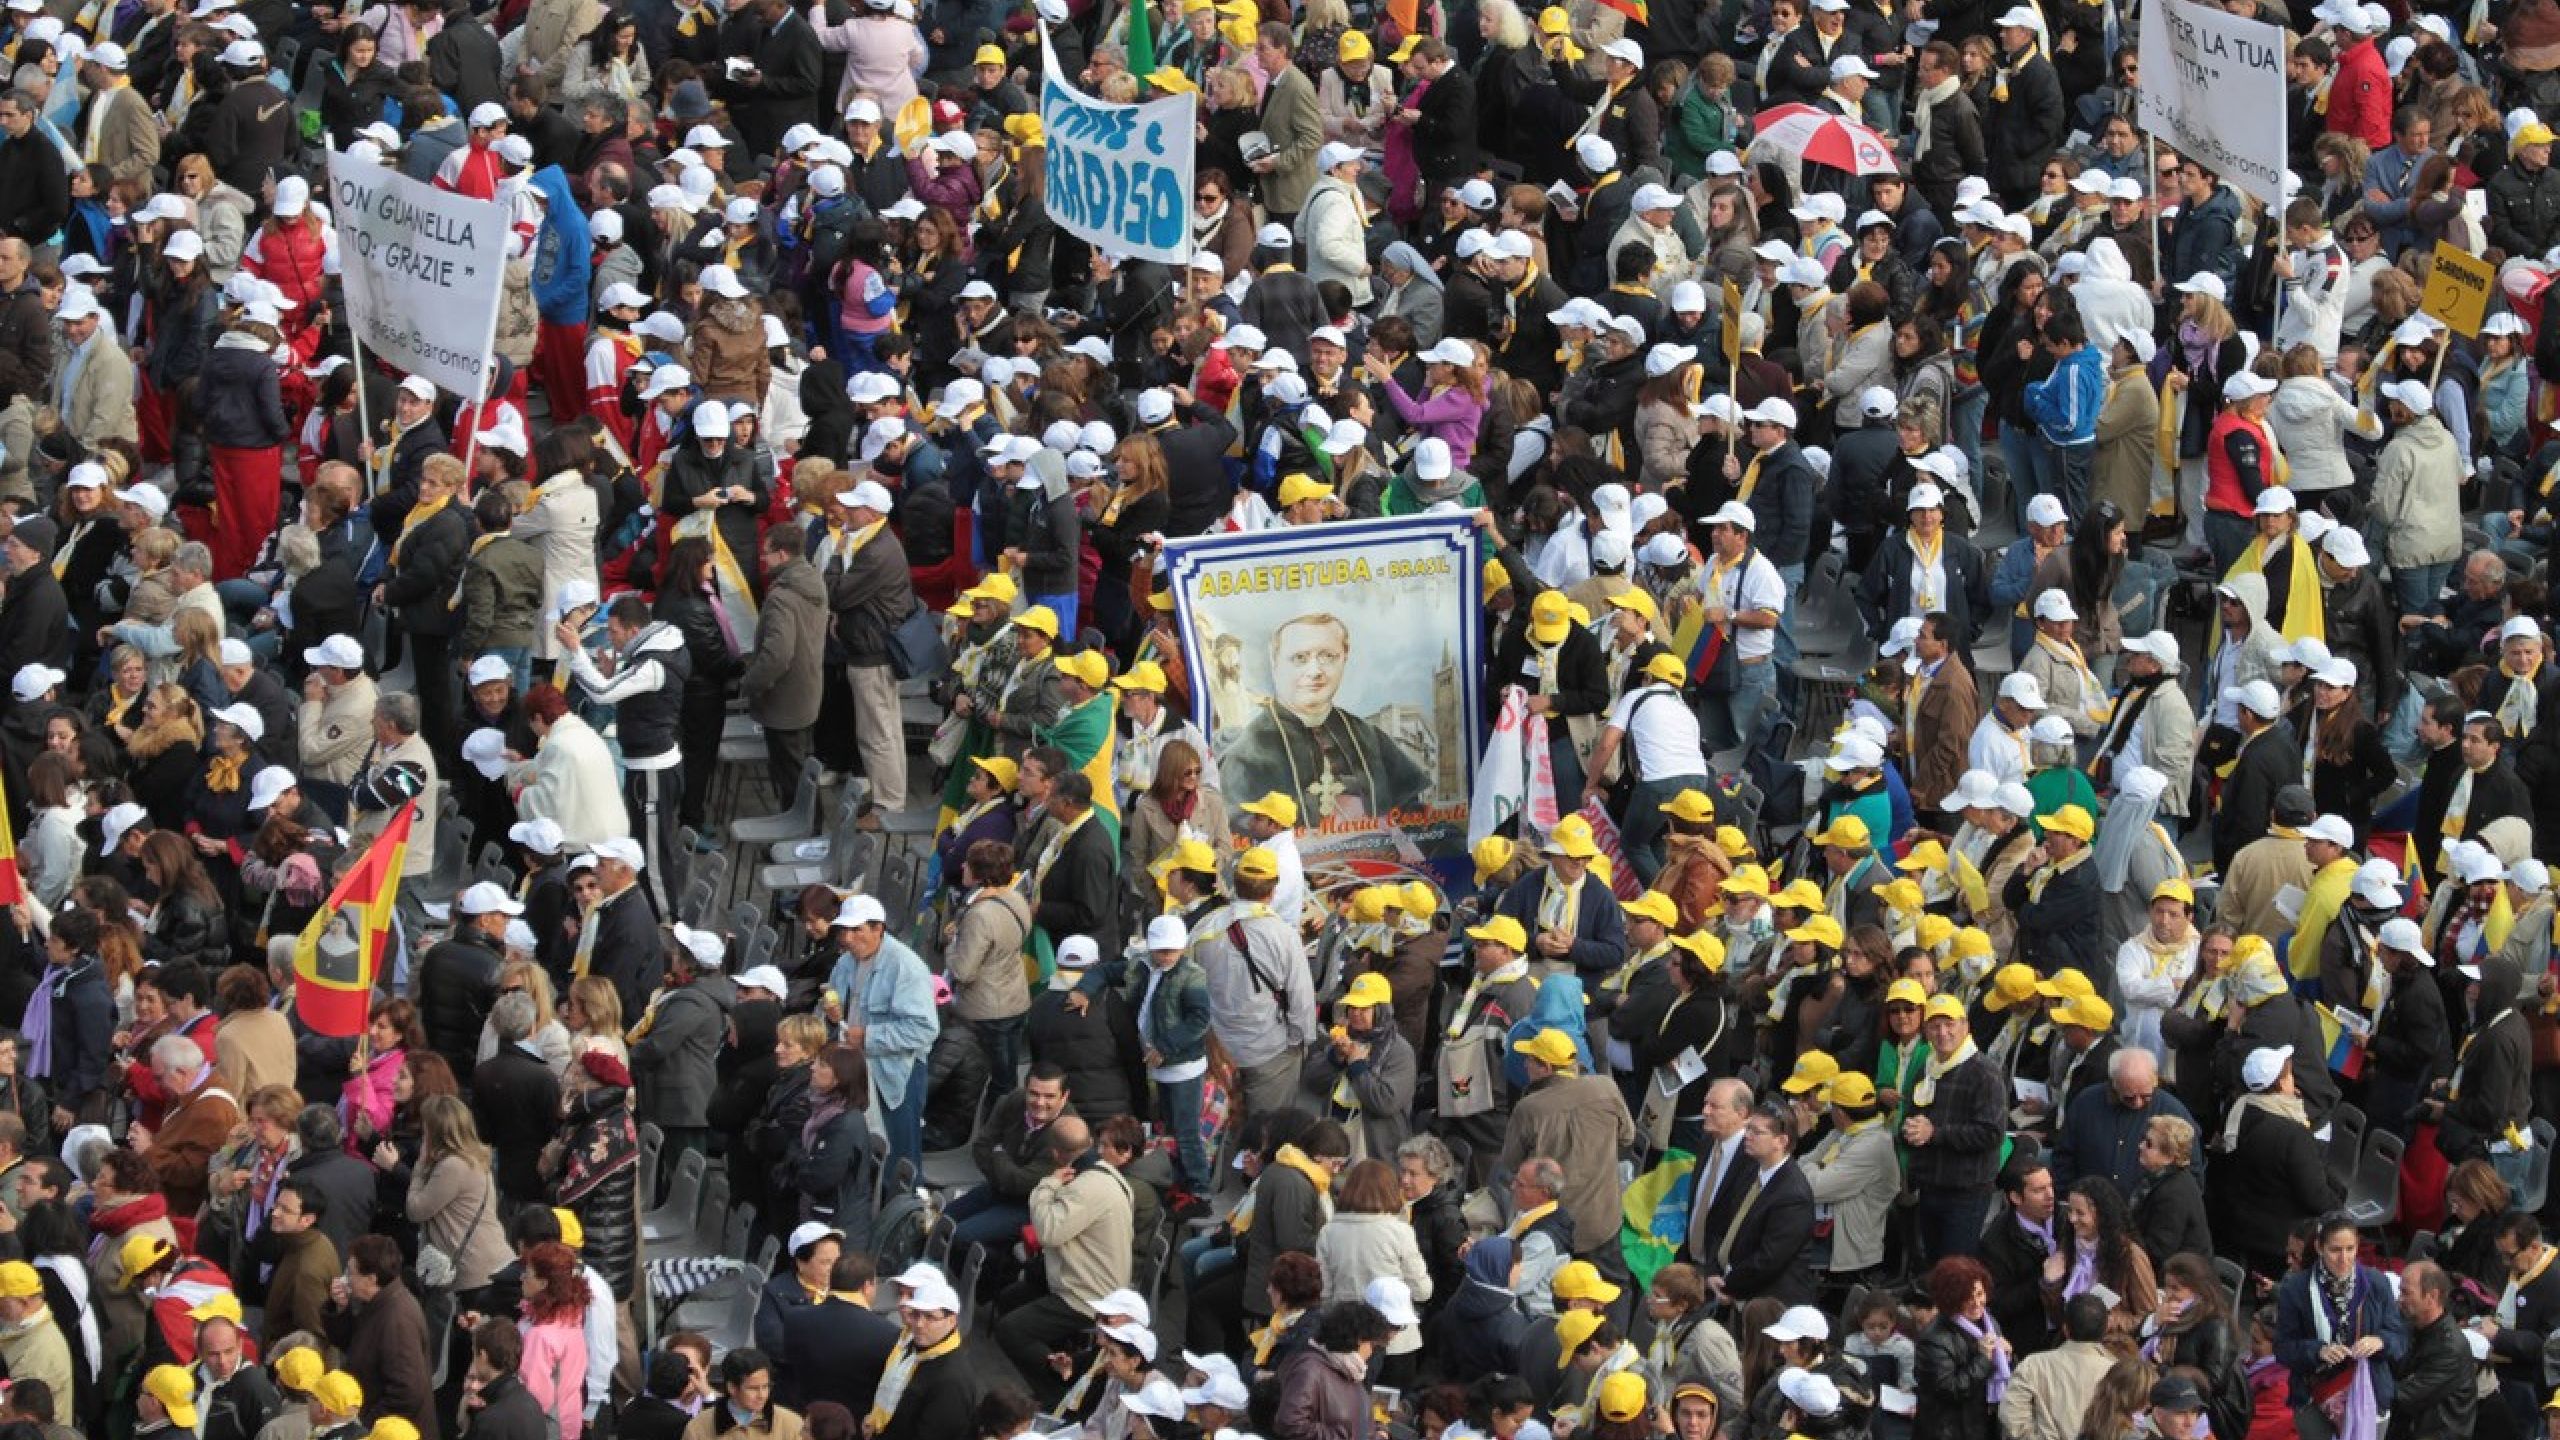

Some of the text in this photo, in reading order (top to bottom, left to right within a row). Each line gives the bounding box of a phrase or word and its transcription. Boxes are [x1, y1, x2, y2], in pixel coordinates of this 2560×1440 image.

[2202, 28, 2228, 59] LA
[2234, 38, 2278, 73] TUA
[2212, 138, 2279, 185] Saronno
[378, 193, 475, 250] GUANELLA
[385, 242, 454, 287] GRAZIE
[2439, 285, 2459, 319] 2
[412, 329, 481, 376] Saronno
[1199, 556, 1372, 599] ABAETETUBA
[1388, 554, 1450, 579] BRASIL
